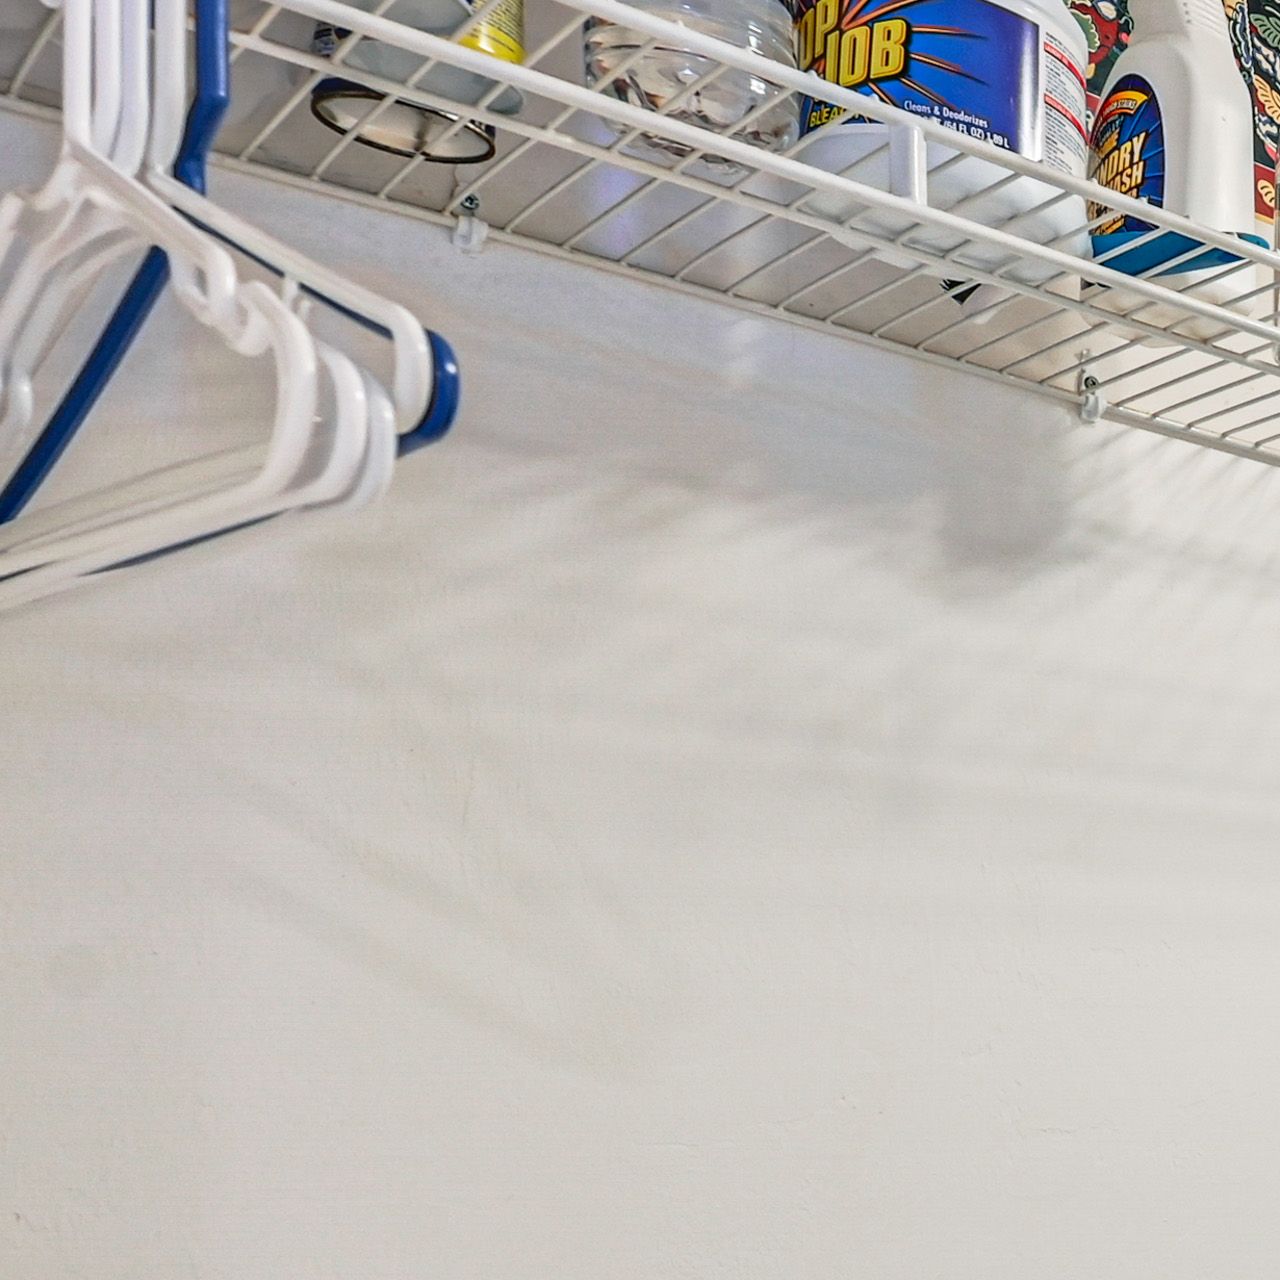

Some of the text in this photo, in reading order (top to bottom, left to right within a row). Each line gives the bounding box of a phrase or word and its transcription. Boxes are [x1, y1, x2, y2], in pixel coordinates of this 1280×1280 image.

[903, 100, 932, 114] Cleans
[942, 107, 988, 129] Deodorizes
[1097, 131, 1147, 187] NDRY
[1108, 160, 1144, 194] ASH
